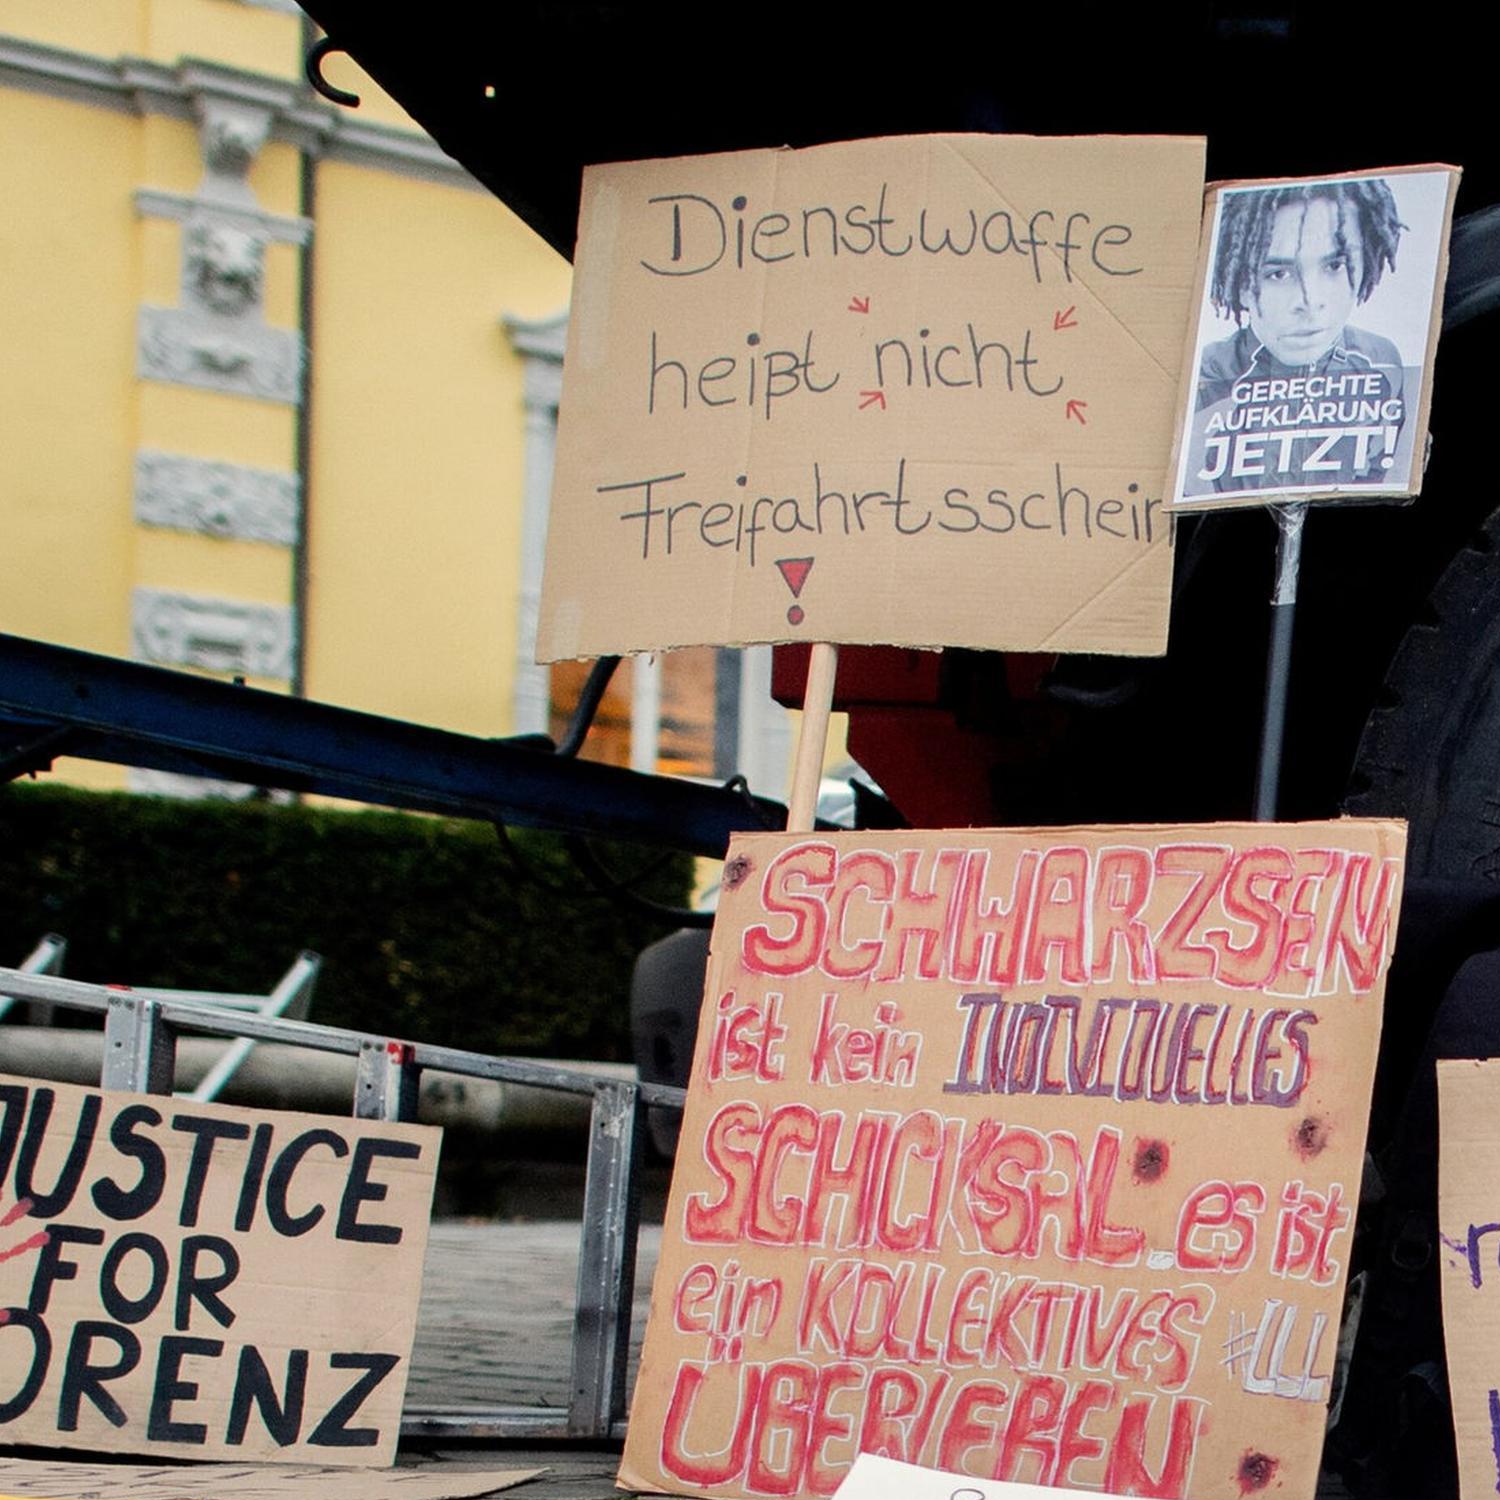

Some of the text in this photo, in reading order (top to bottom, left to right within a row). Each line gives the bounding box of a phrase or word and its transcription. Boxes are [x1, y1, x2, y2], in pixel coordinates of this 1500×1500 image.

[641, 184, 1144, 284] Dienstwaffe
[649, 321, 1064, 420] heißt nicht
[1204, 398, 1403, 434] AUFKLÄRUNG
[1232, 374, 1384, 404] GERECHTE
[1197, 426, 1399, 481] JETZT!
[597, 459, 1174, 567] Freifahrtsschein
[708, 992, 787, 1085] ist
[809, 992, 924, 1089] kein
[27, 1224, 240, 1332] FOR
[1172, 1178, 1266, 1274] es
[1269, 1180, 1351, 1287] ist
[671, 1259, 784, 1338] ein
[0, 1307, 402, 1447] ORENZ
